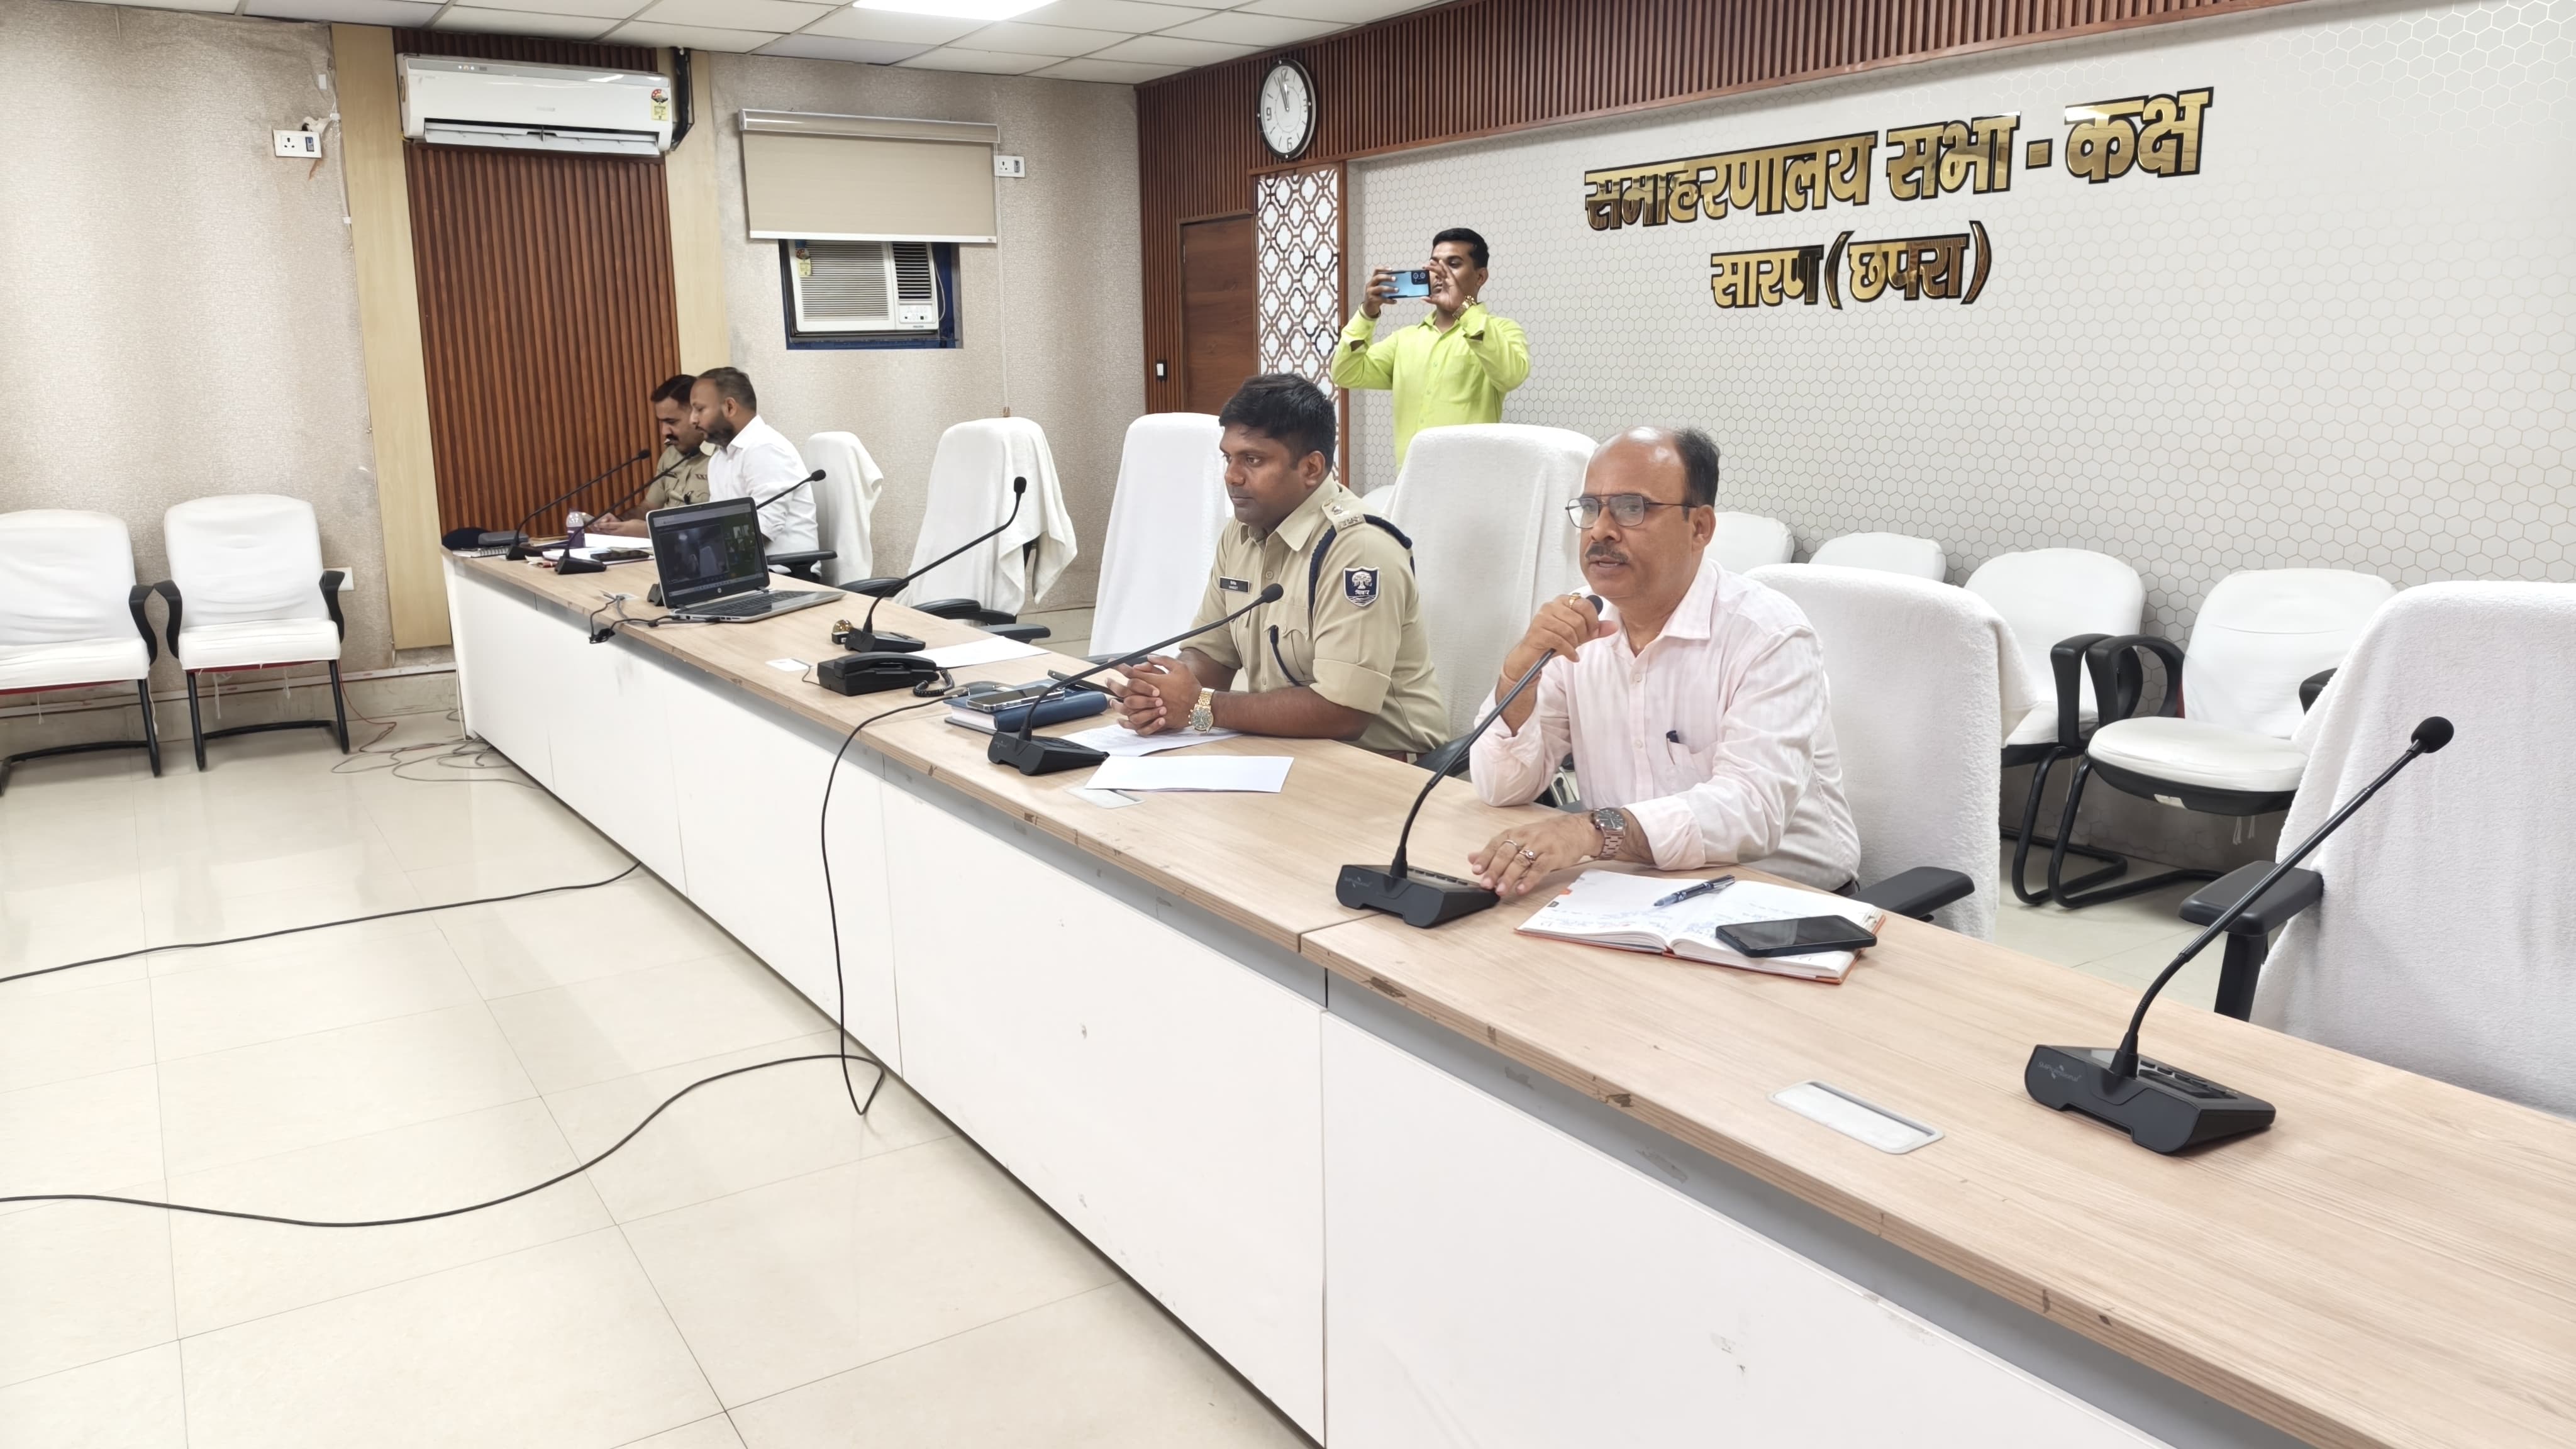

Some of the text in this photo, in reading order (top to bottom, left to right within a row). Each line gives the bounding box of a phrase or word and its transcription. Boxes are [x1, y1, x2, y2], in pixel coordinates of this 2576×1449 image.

[1585, 131, 1879, 231] समाहरणालय
[1886, 111, 2021, 201] सभा
[2065, 87, 2214, 184] कक्ष
[1711, 220, 1992, 310] सारण (छपरा)
